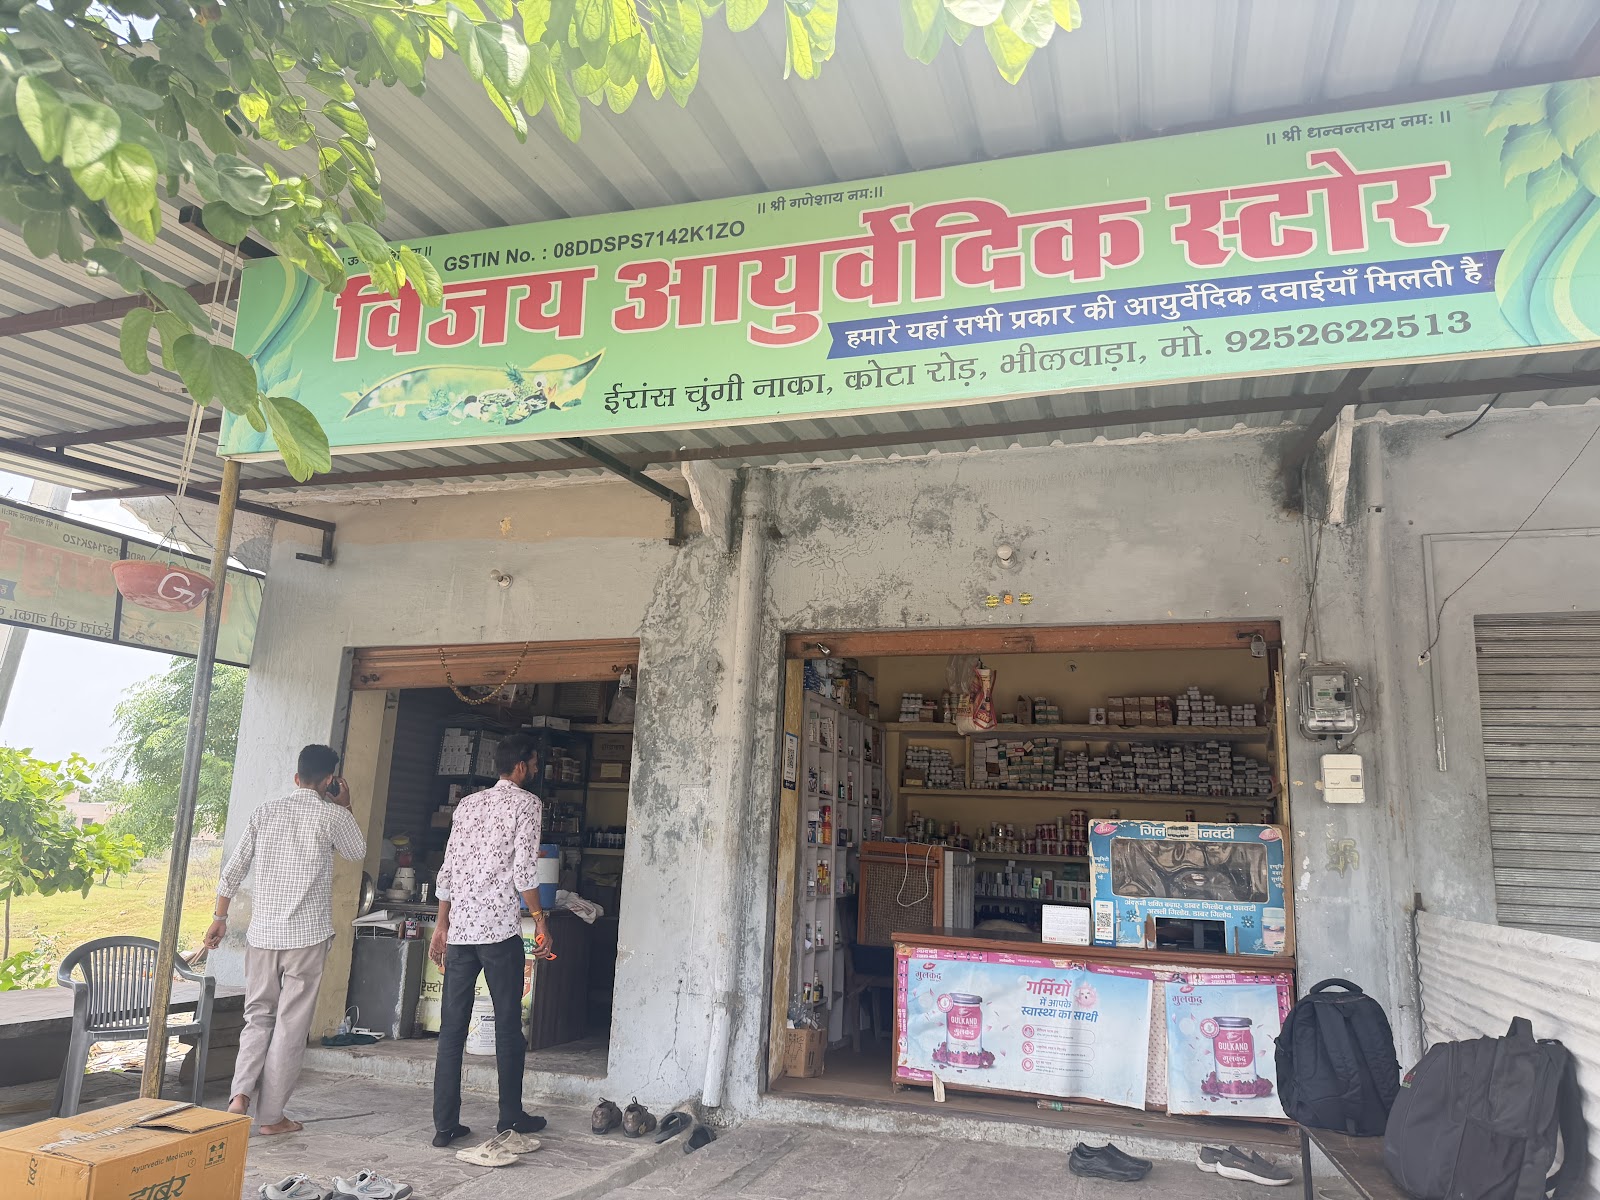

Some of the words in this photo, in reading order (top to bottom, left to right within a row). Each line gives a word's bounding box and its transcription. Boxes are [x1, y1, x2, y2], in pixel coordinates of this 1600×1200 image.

[1282, 121, 1301, 142] श्री
[1307, 117, 1395, 140] धन्वन्तराय
[770, 194, 786, 212] श्री
[789, 191, 844, 210] गणेशाय
[333, 265, 598, 362] विजय
[612, 197, 1150, 348] आयुर्वेदिक
[1166, 148, 1451, 269] स्टोर
[443, 247, 499, 272] GSTIN
[505, 247, 536, 265] No.
[552, 219, 746, 259] 08DDSPS7142K1ZO
[845, 319, 900, 349] हमारे
[906, 316, 949, 340] यहां
[953, 307, 1003, 336] सभी
[1008, 304, 1077, 331] प्रकार
[1081, 295, 1117, 320] की
[1123, 284, 1253, 321] आयुर्वेदिक
[1258, 267, 1359, 303] दवाईयाँ
[1364, 259, 1454, 294] मिलती
[1460, 256, 1484, 285] है
[604, 382, 677, 415] ईरांस
[684, 373, 745, 412] चुंगी
[752, 374, 833, 399] नाका,
[844, 359, 917, 391] कोटा
[1000, 342, 1147, 374] भीलवाड़ा,
[1157, 325, 1212, 358] मो.
[1225, 310, 1472, 354] 9252622513
[1197, 826, 1235, 840] नवटी
[1026, 978, 1072, 997] गर्मियों
[1048, 998, 1072, 1009] आपके
[950, 1016, 978, 1025] GULKAND
[1021, 1006, 1057, 1018] स्वास्थ्य
[1059, 1009, 1073, 1020] का
[1073, 1010, 1099, 1023] साथी
[1218, 1042, 1249, 1051] GULKAND
[130, 1156, 165, 1174] Ayurvedic
[165, 1149, 194, 1163] Medicine
